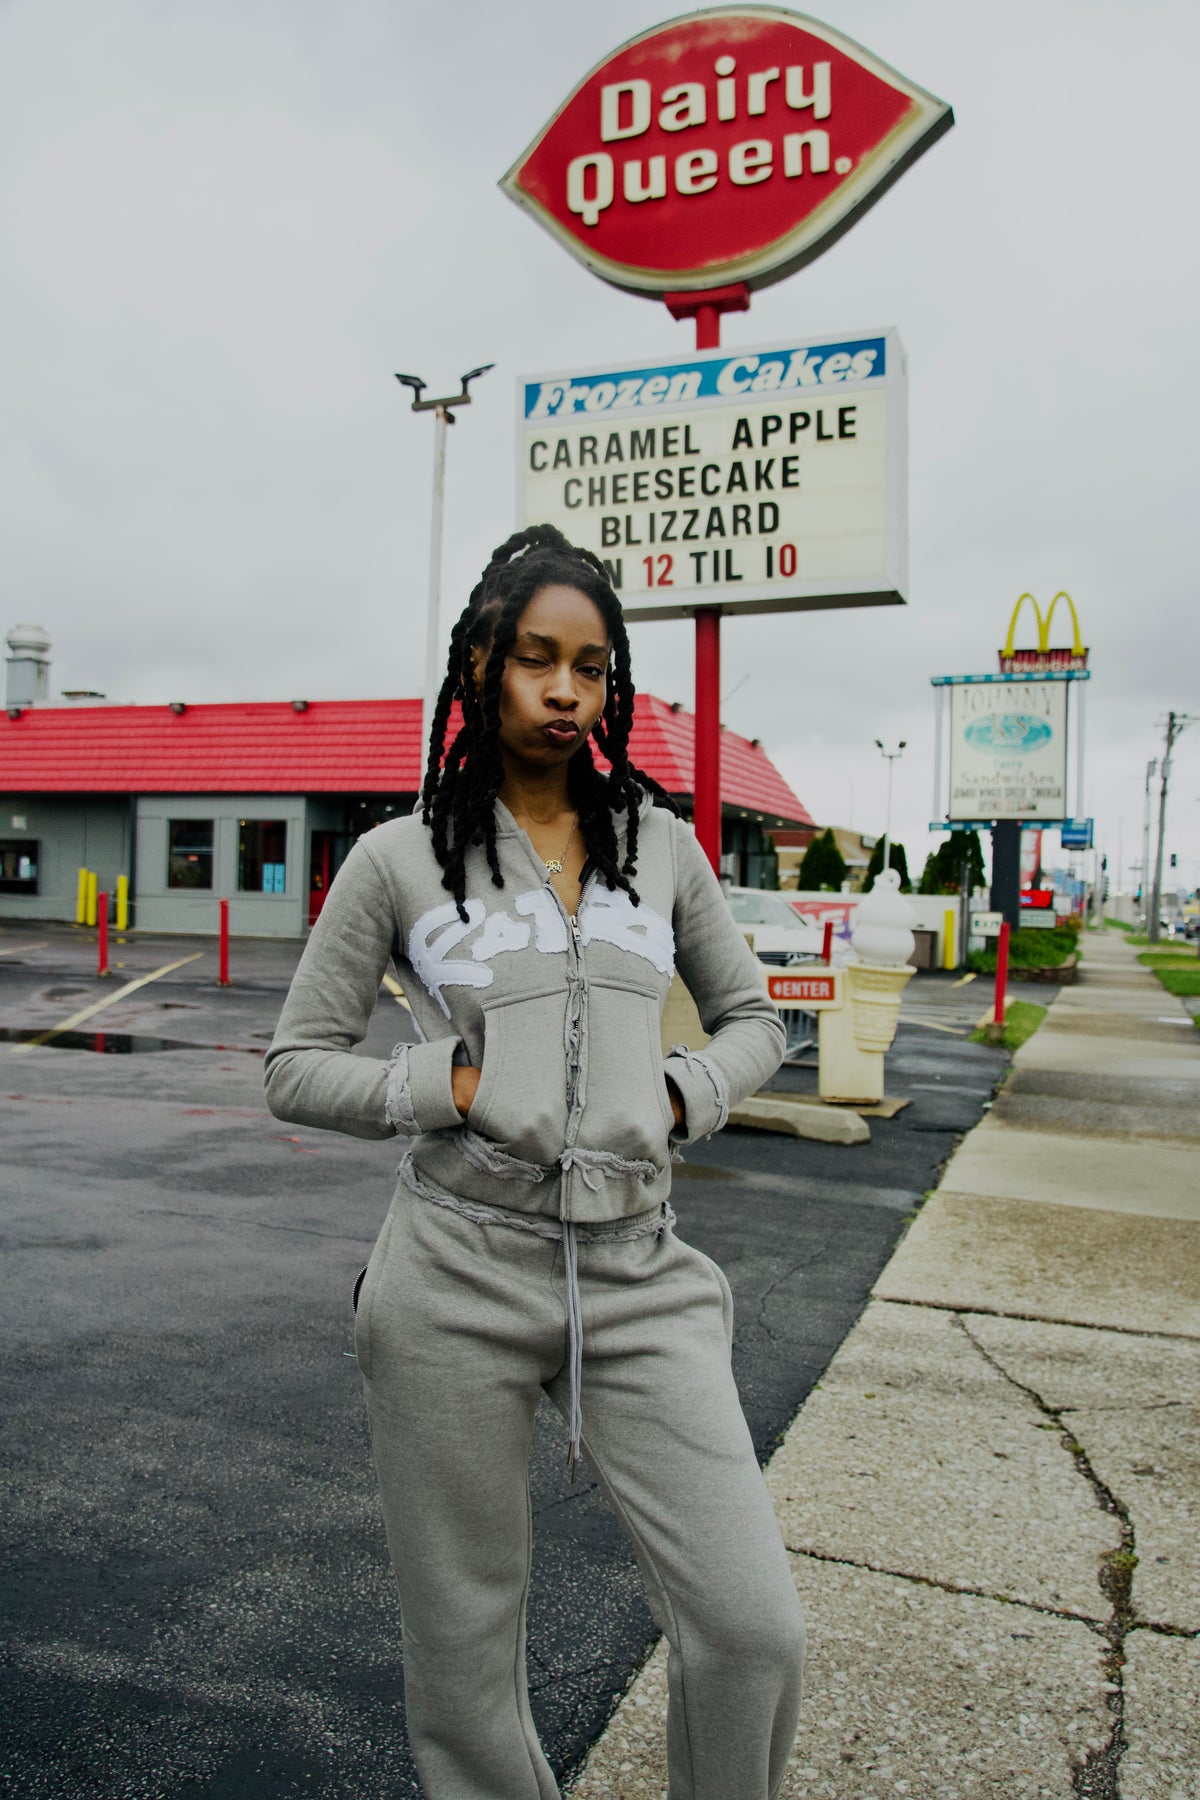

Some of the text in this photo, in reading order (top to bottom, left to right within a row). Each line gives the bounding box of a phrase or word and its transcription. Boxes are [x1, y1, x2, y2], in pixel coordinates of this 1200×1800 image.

[601, 55, 831, 142] Dairy
[528, 348, 878, 418] Frozen Cakes
[529, 406, 857, 472] CARAMEL APPLE
[564, 455, 800, 509] CHEESECAKE
[601, 501, 780, 548] BLIZZARD
[643, 553, 674, 588] 12
[690, 549, 743, 584] TIL
[782, 981, 830, 998] ENTER
